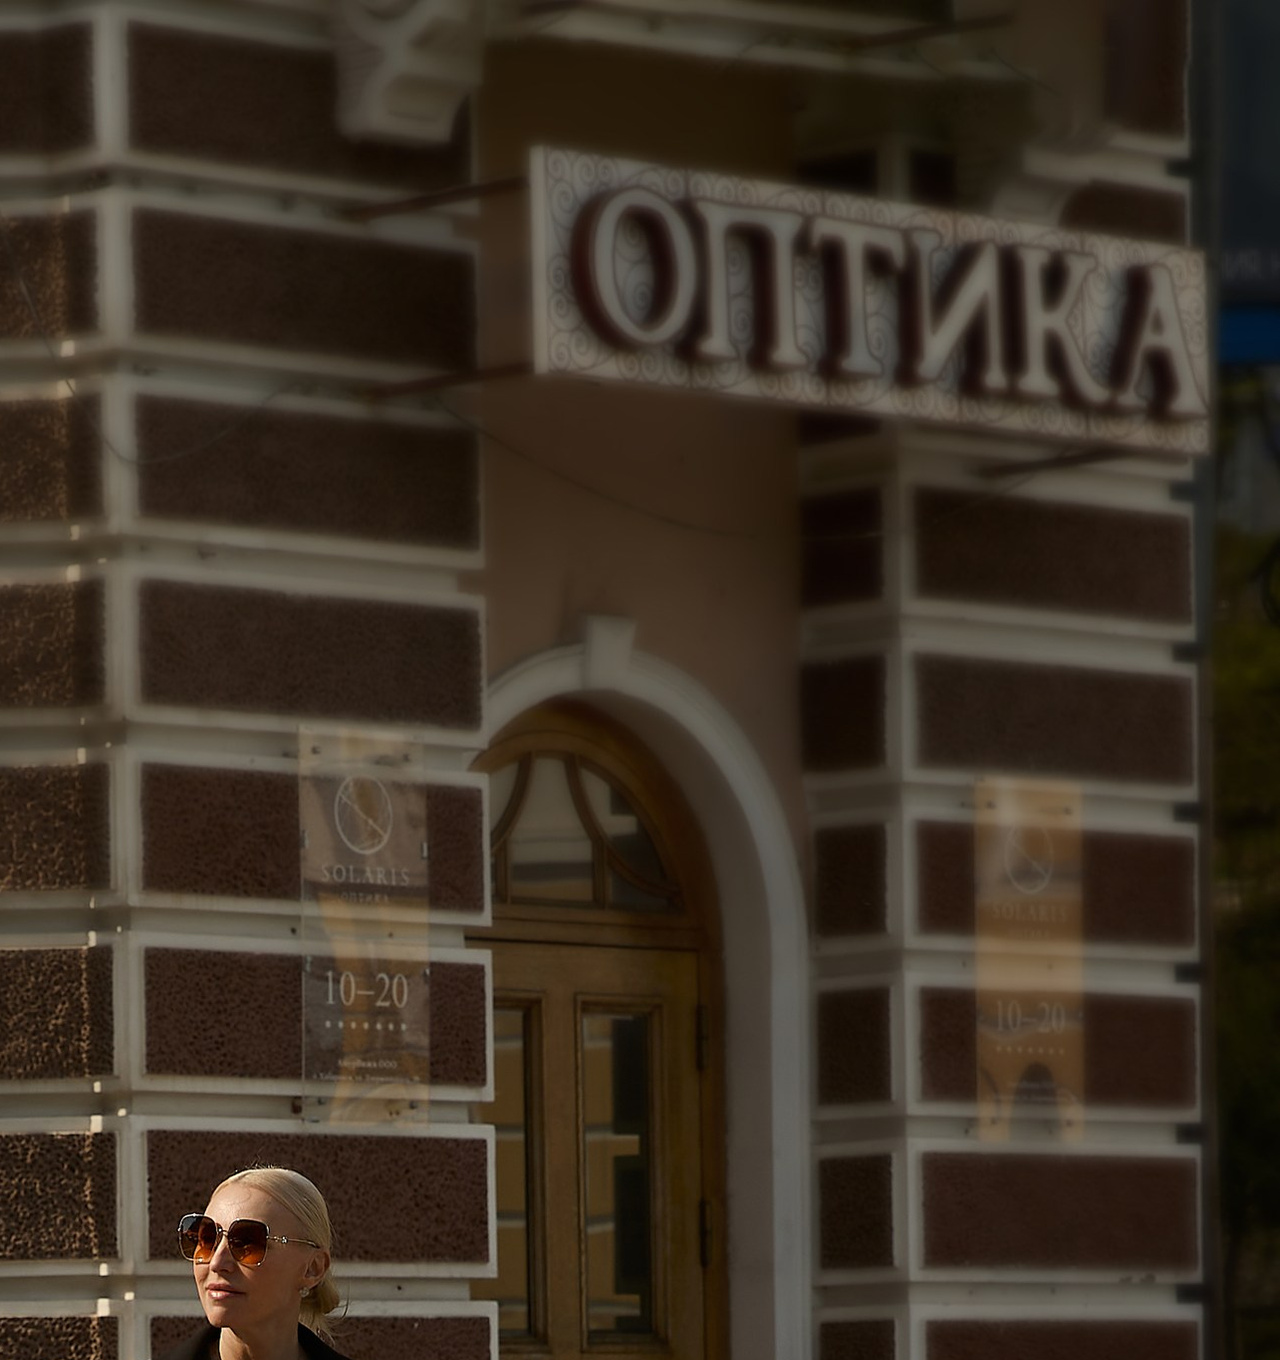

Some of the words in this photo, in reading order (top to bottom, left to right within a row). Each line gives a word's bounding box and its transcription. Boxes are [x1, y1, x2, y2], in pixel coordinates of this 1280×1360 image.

[574, 187, 1209, 418] ОПТИКА
[320, 863, 410, 887] SOLARIS
[990, 901, 1068, 924] SOLARIS
